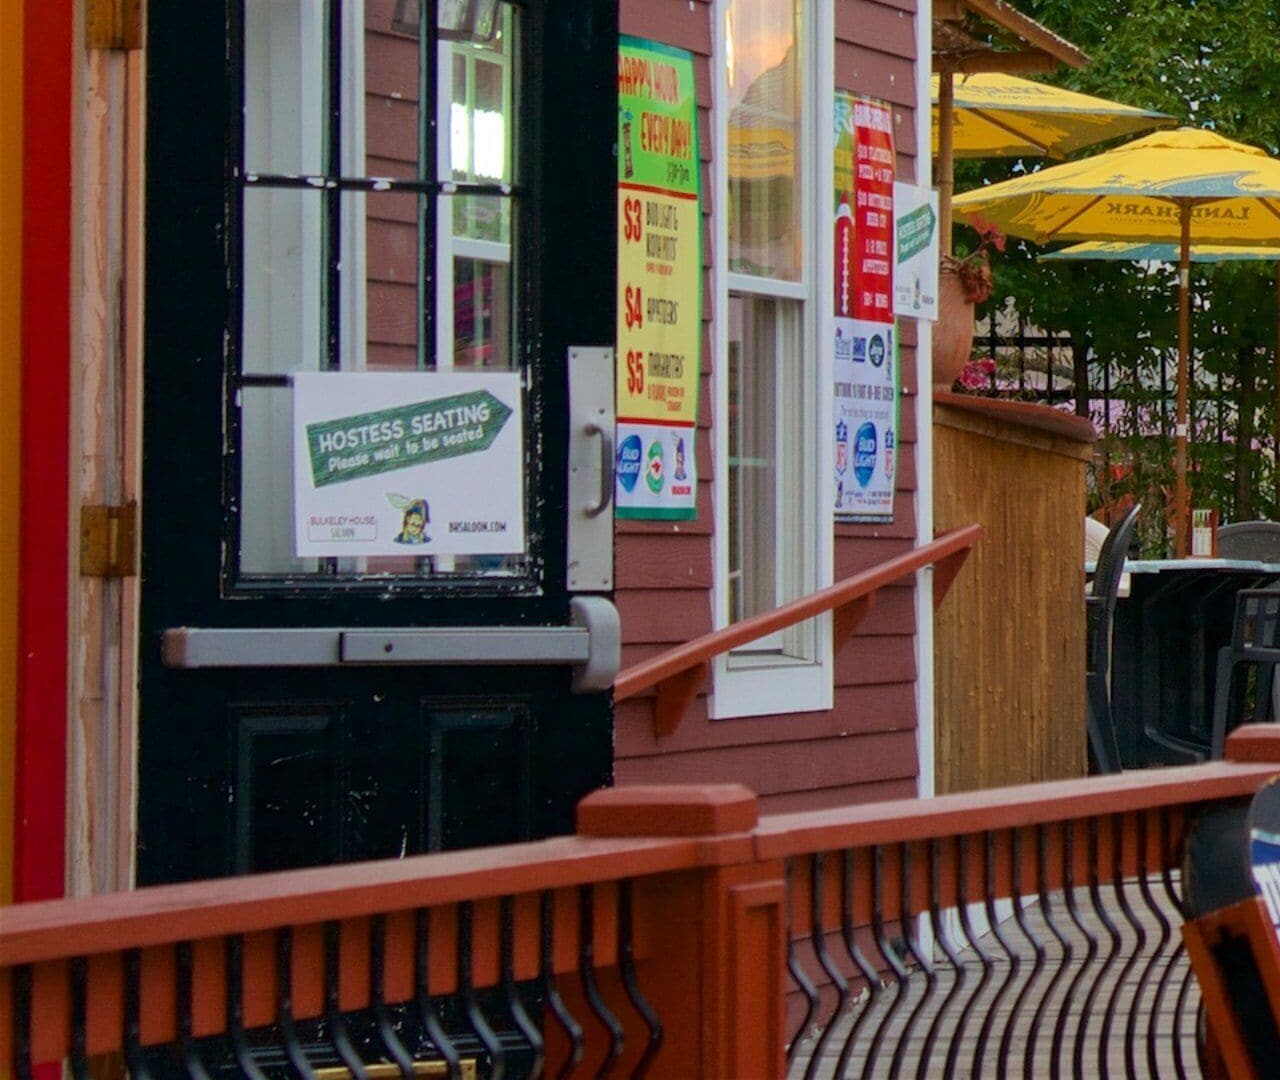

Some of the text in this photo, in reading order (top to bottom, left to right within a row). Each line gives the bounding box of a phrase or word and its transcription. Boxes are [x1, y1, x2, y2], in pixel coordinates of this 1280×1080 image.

[624, 195, 642, 245] $3
[625, 283, 643, 332] $4
[627, 349, 644, 397] $5
[318, 402, 491, 453] HOSTESS SEATING
[328, 425, 485, 472] Please wait to be seated
[858, 437, 876, 452] BUD
[622, 447, 639, 460] BUD
